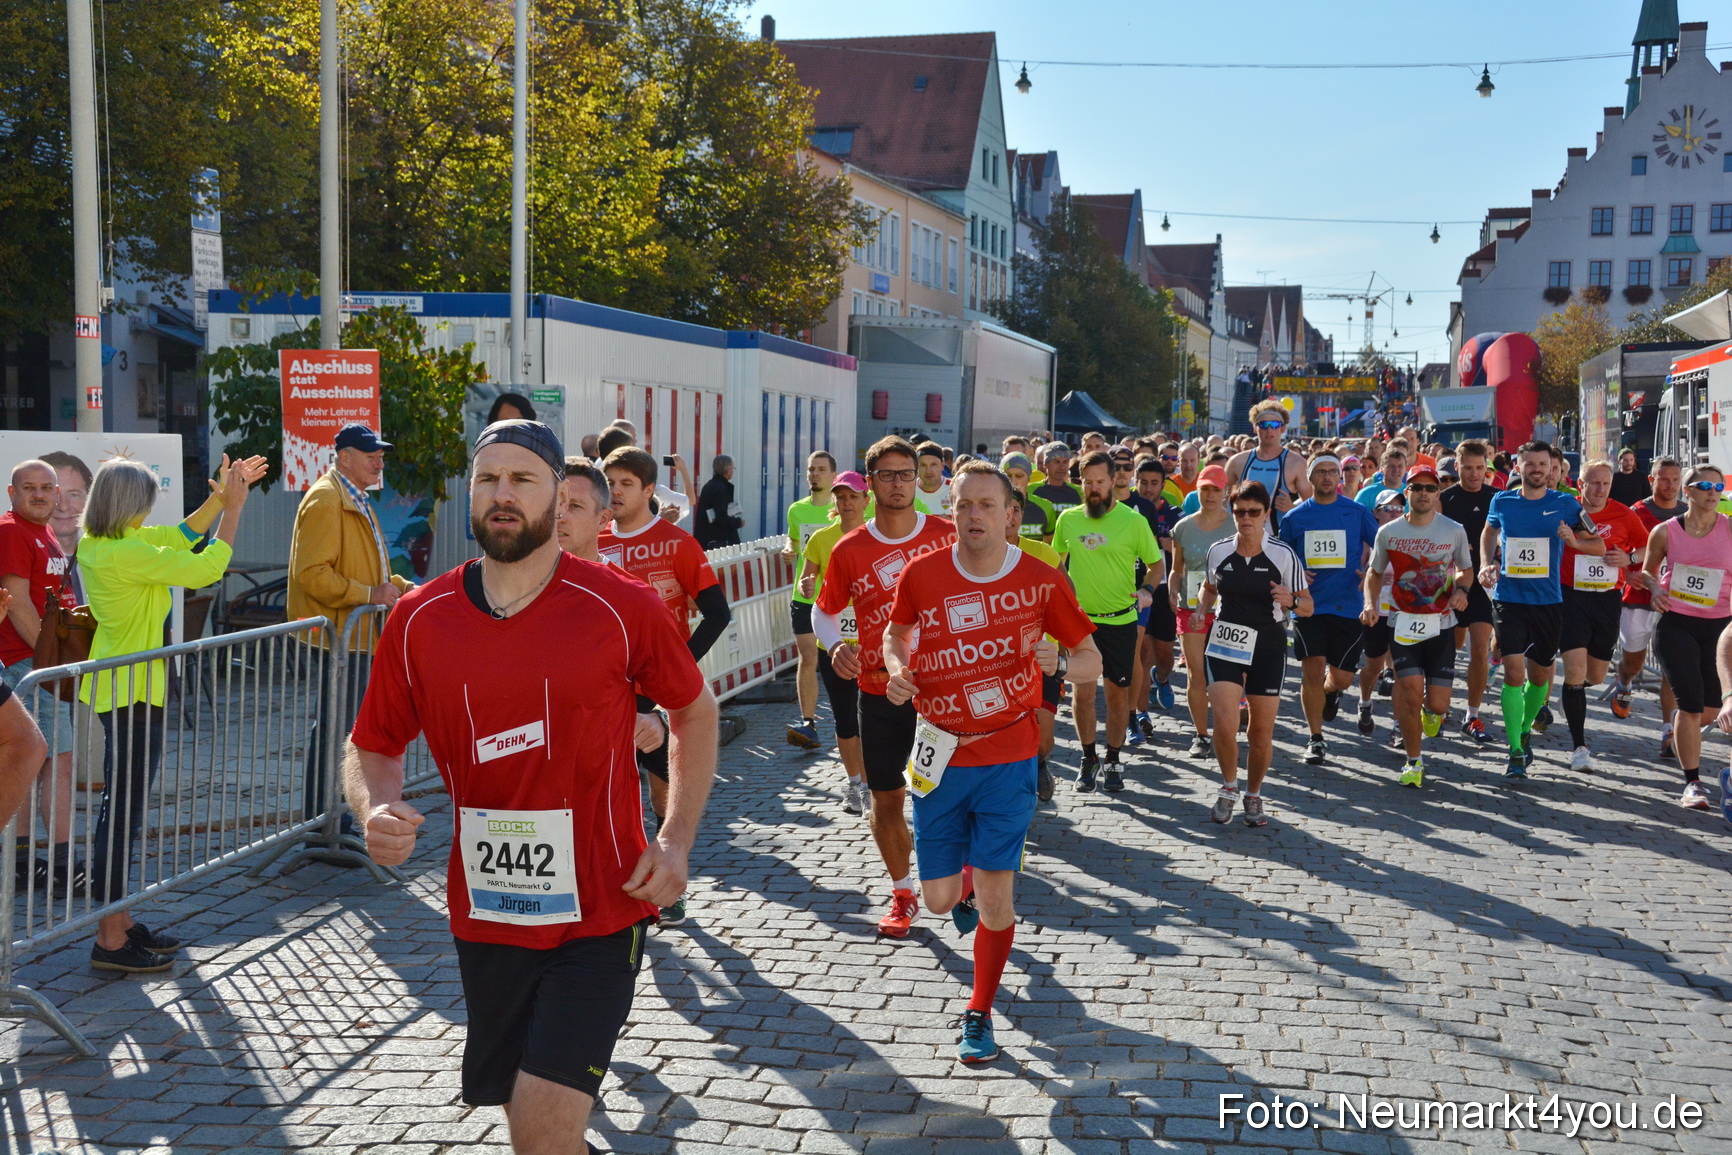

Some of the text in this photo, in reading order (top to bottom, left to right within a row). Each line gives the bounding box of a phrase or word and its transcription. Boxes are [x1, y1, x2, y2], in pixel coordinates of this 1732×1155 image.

[195, 246, 220, 257] Parkschein
[197, 258, 219, 269] werktags
[119, 350, 128, 371] 3
[289, 359, 373, 374] Abschluss
[289, 375, 318, 385] statt
[1306, 380, 1341, 388] START
[290, 385, 374, 399] Ausschluss!
[304, 407, 371, 416] Mehr Lehrer für
[301, 417, 336, 427] kleinere
[1053, 503, 1077, 511] OCK
[1018, 524, 1044, 534] CK
[1314, 540, 1337, 552] 319
[1388, 537, 1430, 546] FINISHER
[1395, 542, 1452, 552] RELAY TEAM
[1518, 549, 1535, 561] 43
[627, 560, 662, 572] schenken
[875, 553, 902, 570] raumbox
[1588, 565, 1604, 577] 96
[1686, 575, 1705, 590] 95
[947, 595, 981, 607] raumbox
[1679, 593, 1705, 604] Manuela
[993, 611, 1035, 625] schenken
[840, 619, 858, 632] 29
[1409, 621, 1426, 634] 42
[1216, 624, 1249, 645] 3062
[917, 635, 1015, 674] raumbox
[943, 668, 977, 681] wohnen
[982, 658, 1016, 673] outdoor
[966, 680, 999, 694] raumbox
[496, 733, 527, 751] DEHN
[488, 820, 536, 833] BOCK
[476, 841, 556, 877] 2442
[487, 879, 541, 890] PARTL Neumarkt
[498, 895, 541, 914] Jürgen
